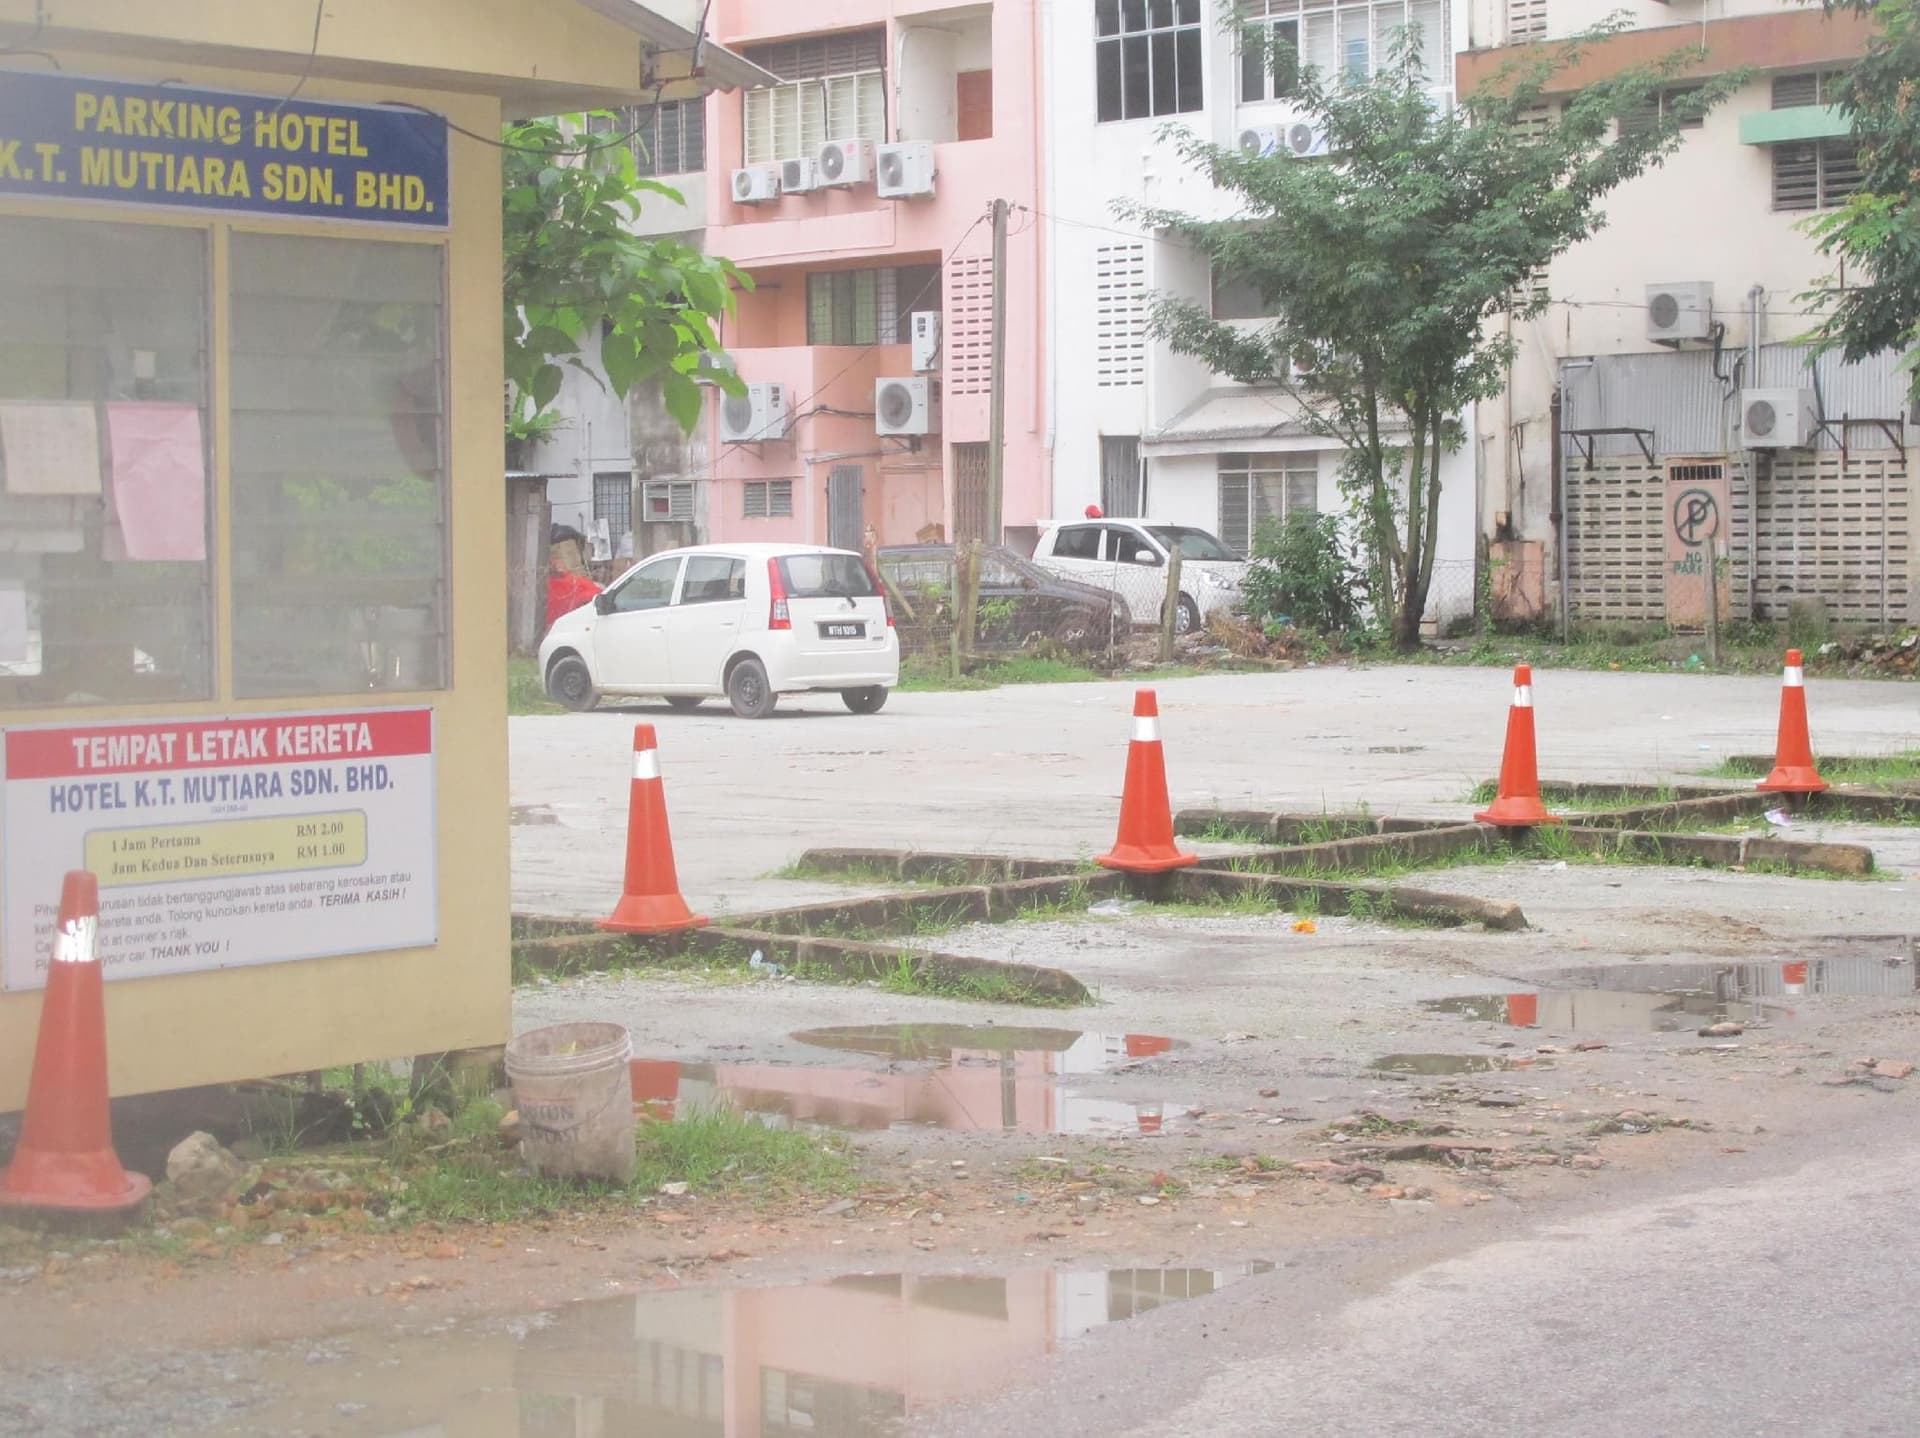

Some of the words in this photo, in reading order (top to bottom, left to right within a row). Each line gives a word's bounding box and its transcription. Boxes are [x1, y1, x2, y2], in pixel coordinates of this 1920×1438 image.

[74, 92, 241, 145] PARKING
[254, 111, 368, 157] HOTEL
[0, 139, 66, 184] K.T.
[81, 146, 250, 198] MUTIARA
[262, 162, 343, 206] SDN.
[355, 170, 434, 213] BHD.
[72, 732, 177, 768] TEMPAT
[186, 727, 268, 763] LETAK
[276, 722, 373, 757] KERETA
[50, 781, 127, 813] HOTEL
[135, 778, 175, 807] K.T.
[183, 771, 283, 803] MUTIARA
[289, 768, 339, 797] SDN.
[345, 764, 394, 793] BHD.
[121, 838, 147, 852] Jam
[151, 836, 201, 849] Pertama
[296, 824, 318, 838] RM
[321, 822, 344, 836] 2.00
[111, 861, 137, 875] Jam
[141, 858, 181, 873] Kedua
[184, 856, 208, 869] Dan
[211, 851, 275, 867] Seterusnya
[296, 845, 318, 858] RM
[322, 843, 345, 857] 1.00
[137, 893, 163, 906] tidak
[165, 883, 262, 905] bertanggungjawab
[264, 884, 286, 895] atas
[288, 877, 335, 893] sebarang
[337, 874, 387, 889] kerosakan
[390, 872, 411, 884] atau
[168, 910, 203, 923] Tolong
[254, 900, 286, 914] kereta
[319, 894, 361, 908] TERIMA
[366, 888, 400, 903] KASIH
[150, 945, 192, 960] THANK
[194, 941, 220, 954] YOU
